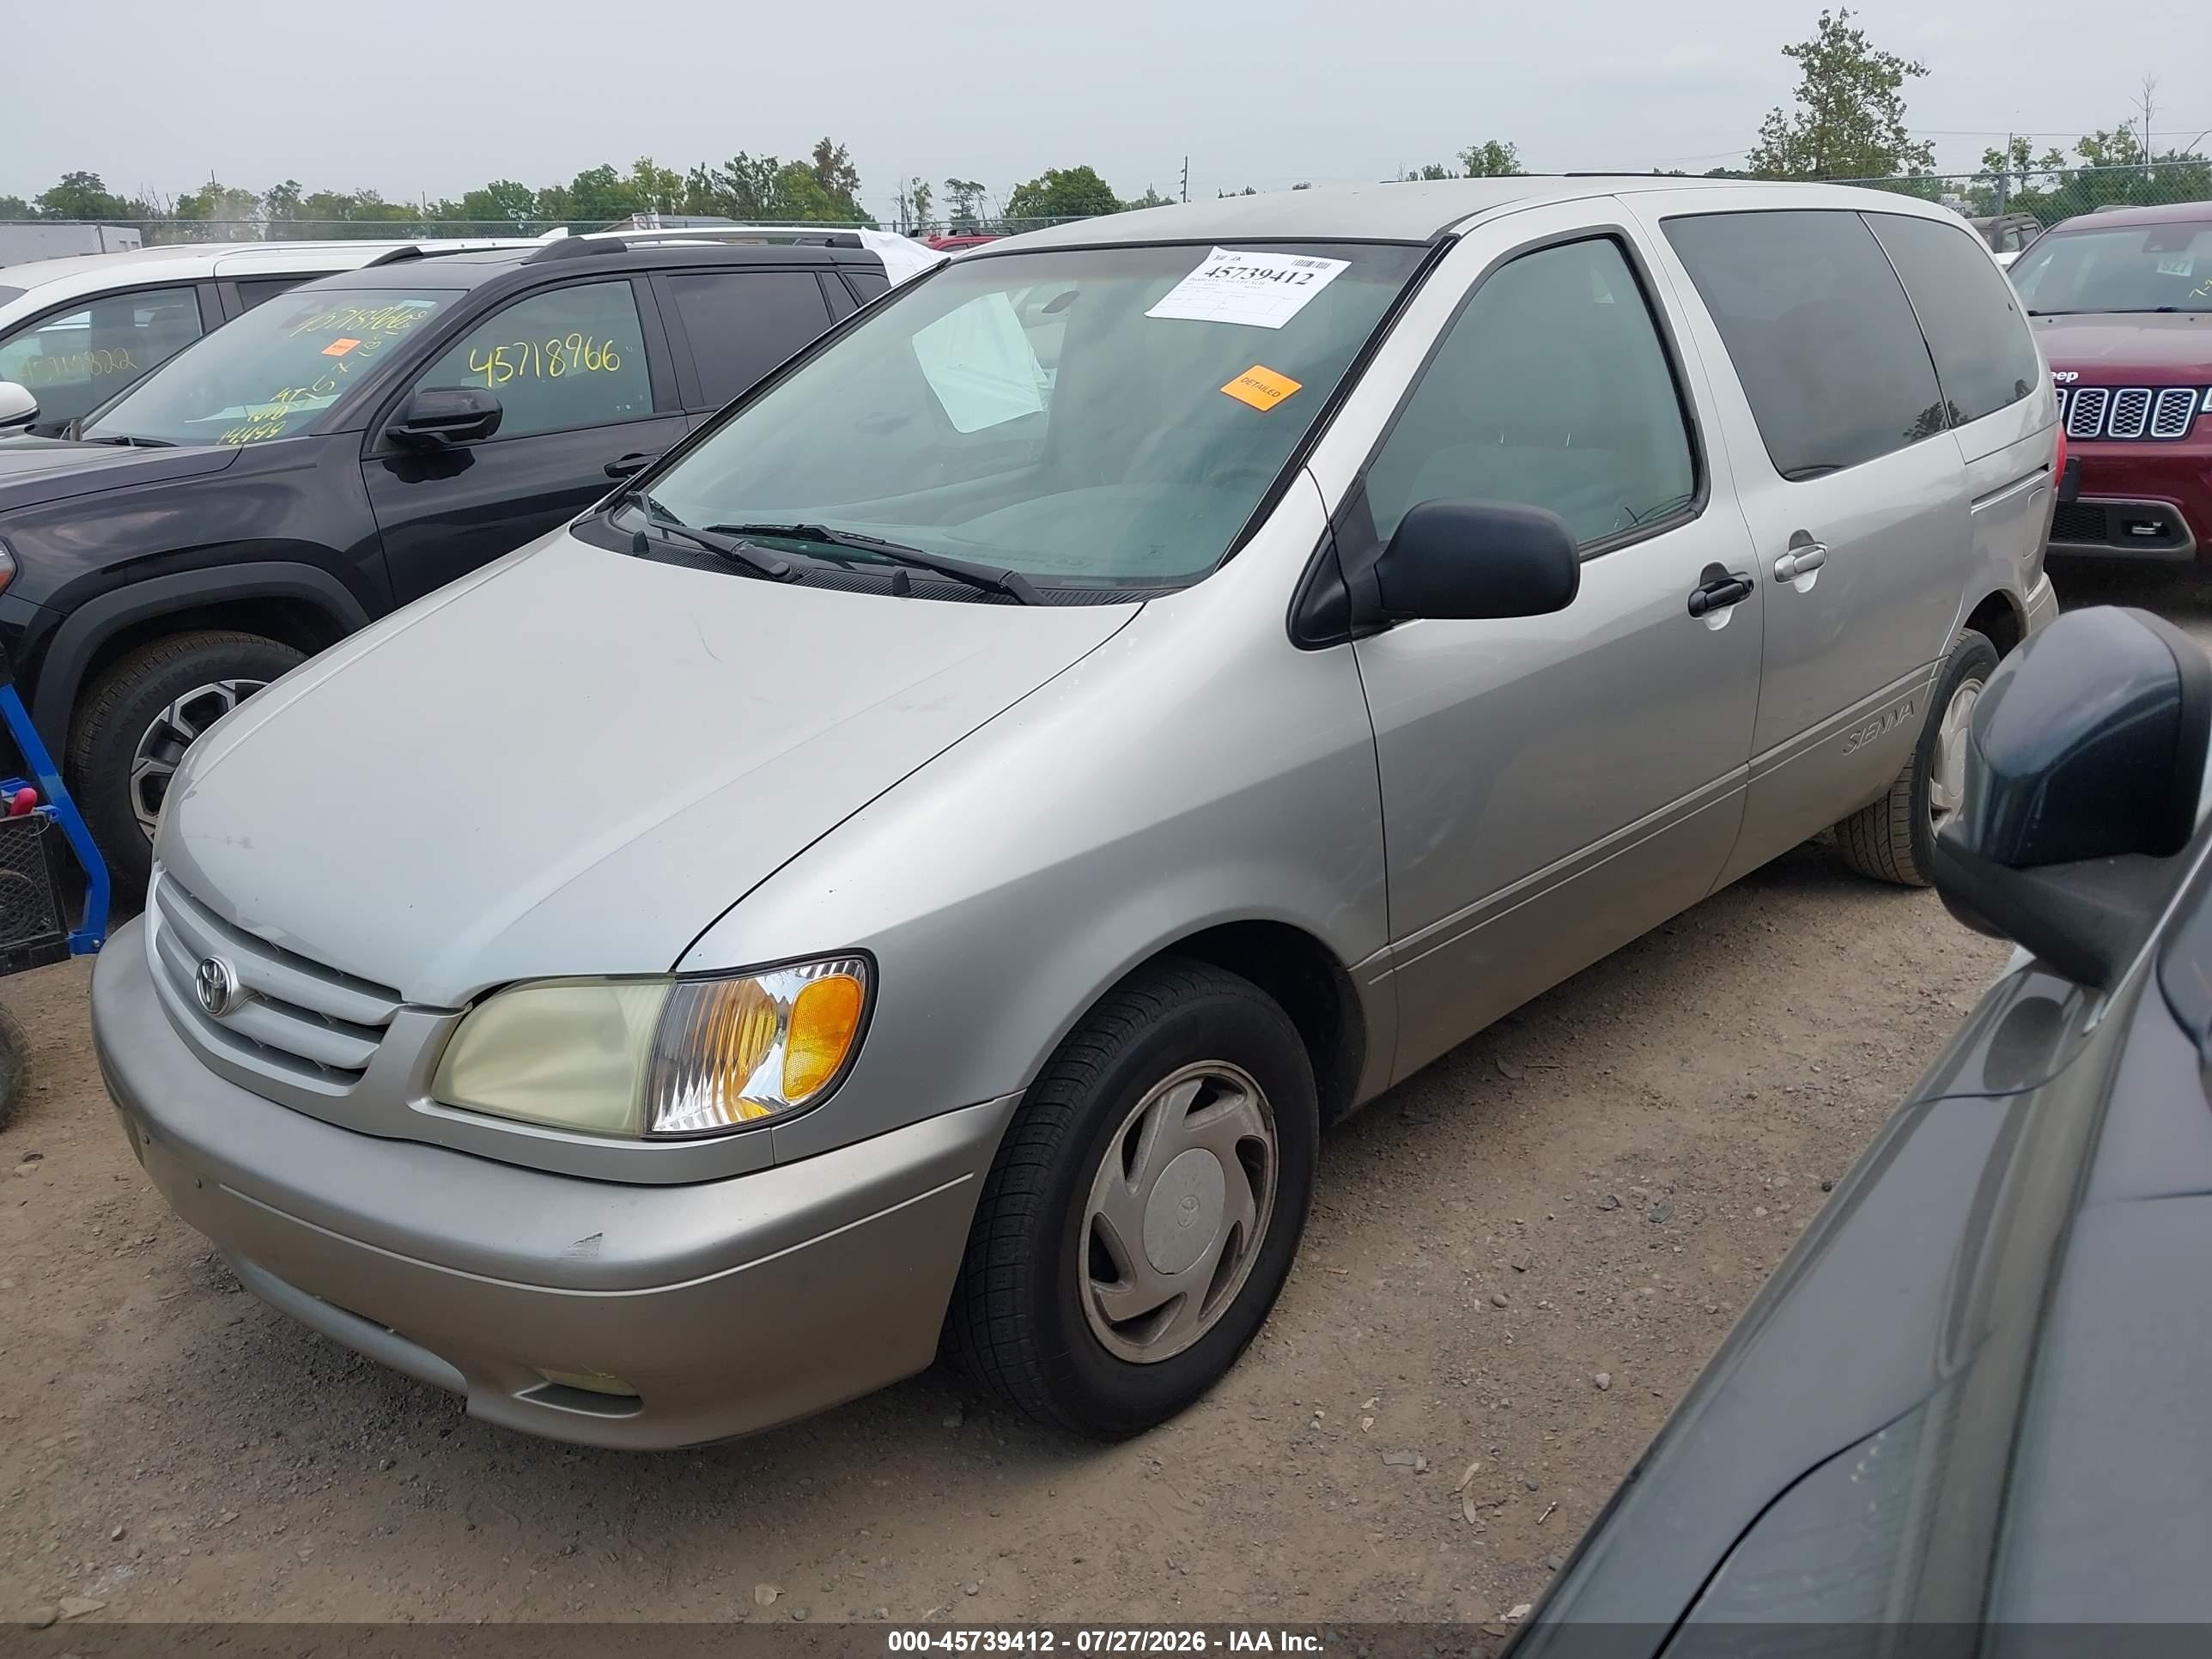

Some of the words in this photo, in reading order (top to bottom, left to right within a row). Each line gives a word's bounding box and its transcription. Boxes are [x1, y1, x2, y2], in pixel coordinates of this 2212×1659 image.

[1204, 265, 1315, 286] 45739412
[469, 332, 621, 388] 45718966
[1240, 375, 1281, 398] DETAILED
[2051, 371, 2079, 383] eep
[1842, 700, 1915, 756] SIENNA
